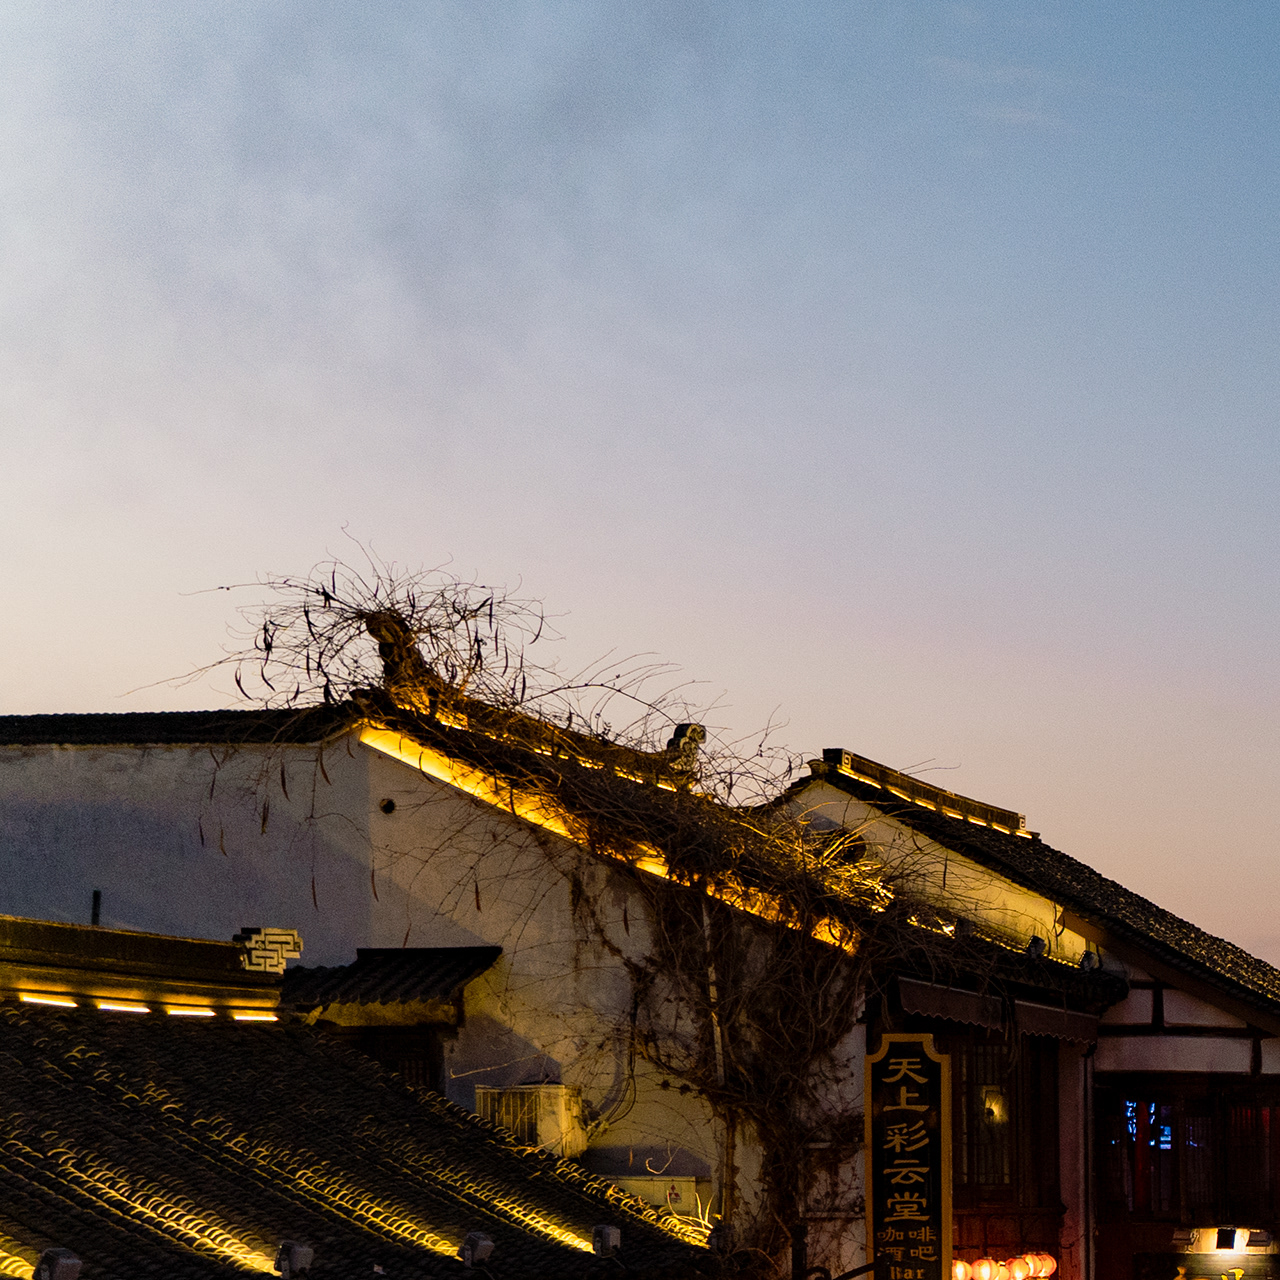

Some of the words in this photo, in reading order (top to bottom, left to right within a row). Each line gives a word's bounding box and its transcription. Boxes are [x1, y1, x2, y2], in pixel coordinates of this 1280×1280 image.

[881, 1057, 931, 1223] 天上彩云堂
[877, 1225, 937, 1242] 咖啡
[878, 1245, 938, 1262] 酒吧
[890, 1266, 925, 1280] Bar
